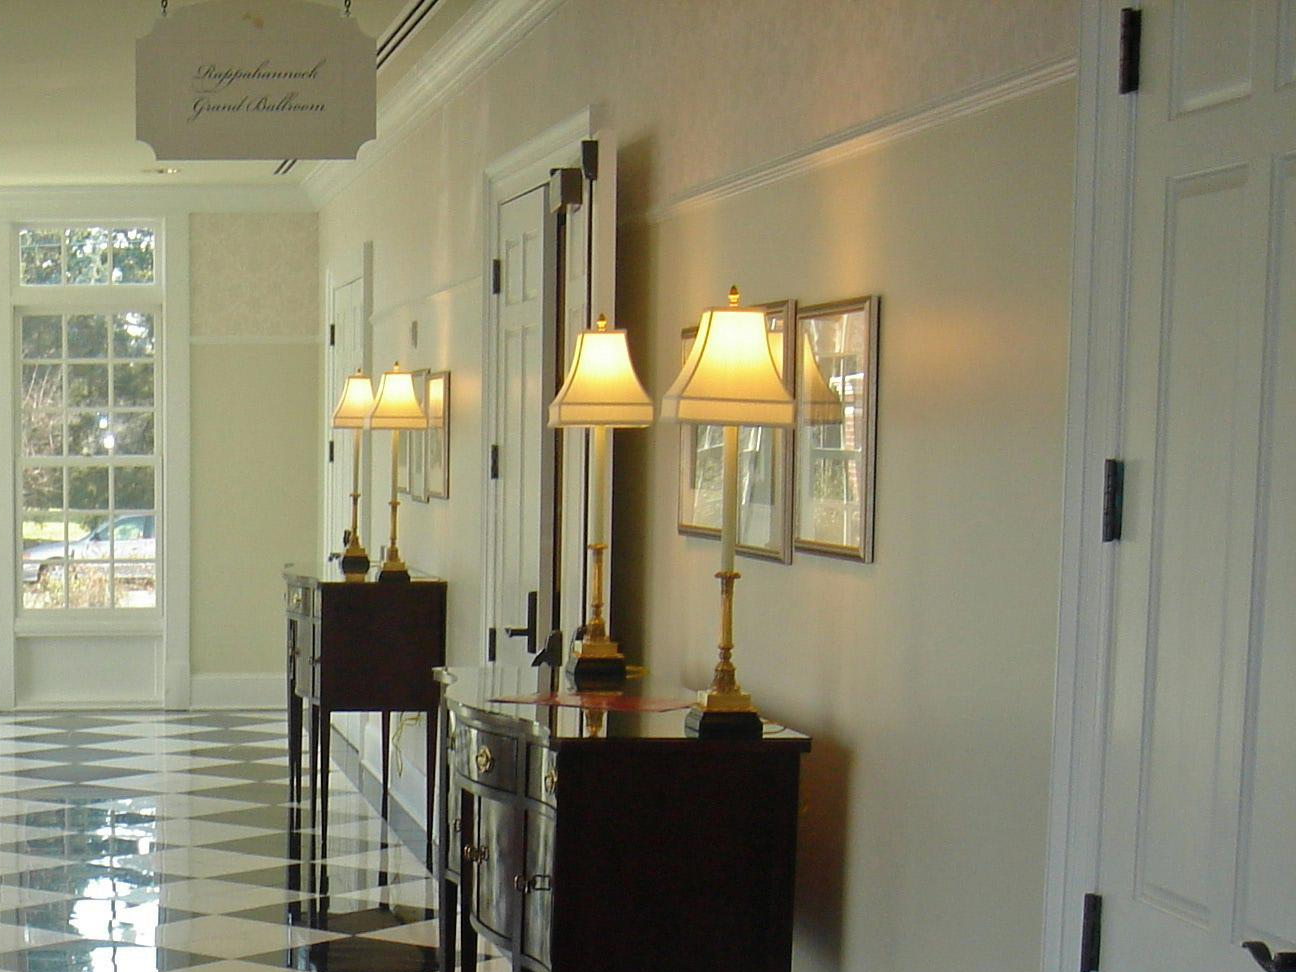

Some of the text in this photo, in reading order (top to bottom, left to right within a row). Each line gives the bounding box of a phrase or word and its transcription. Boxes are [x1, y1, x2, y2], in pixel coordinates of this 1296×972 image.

[195, 58, 326, 92] Rappahannock
[187, 92, 325, 121] Grand Ballroom
